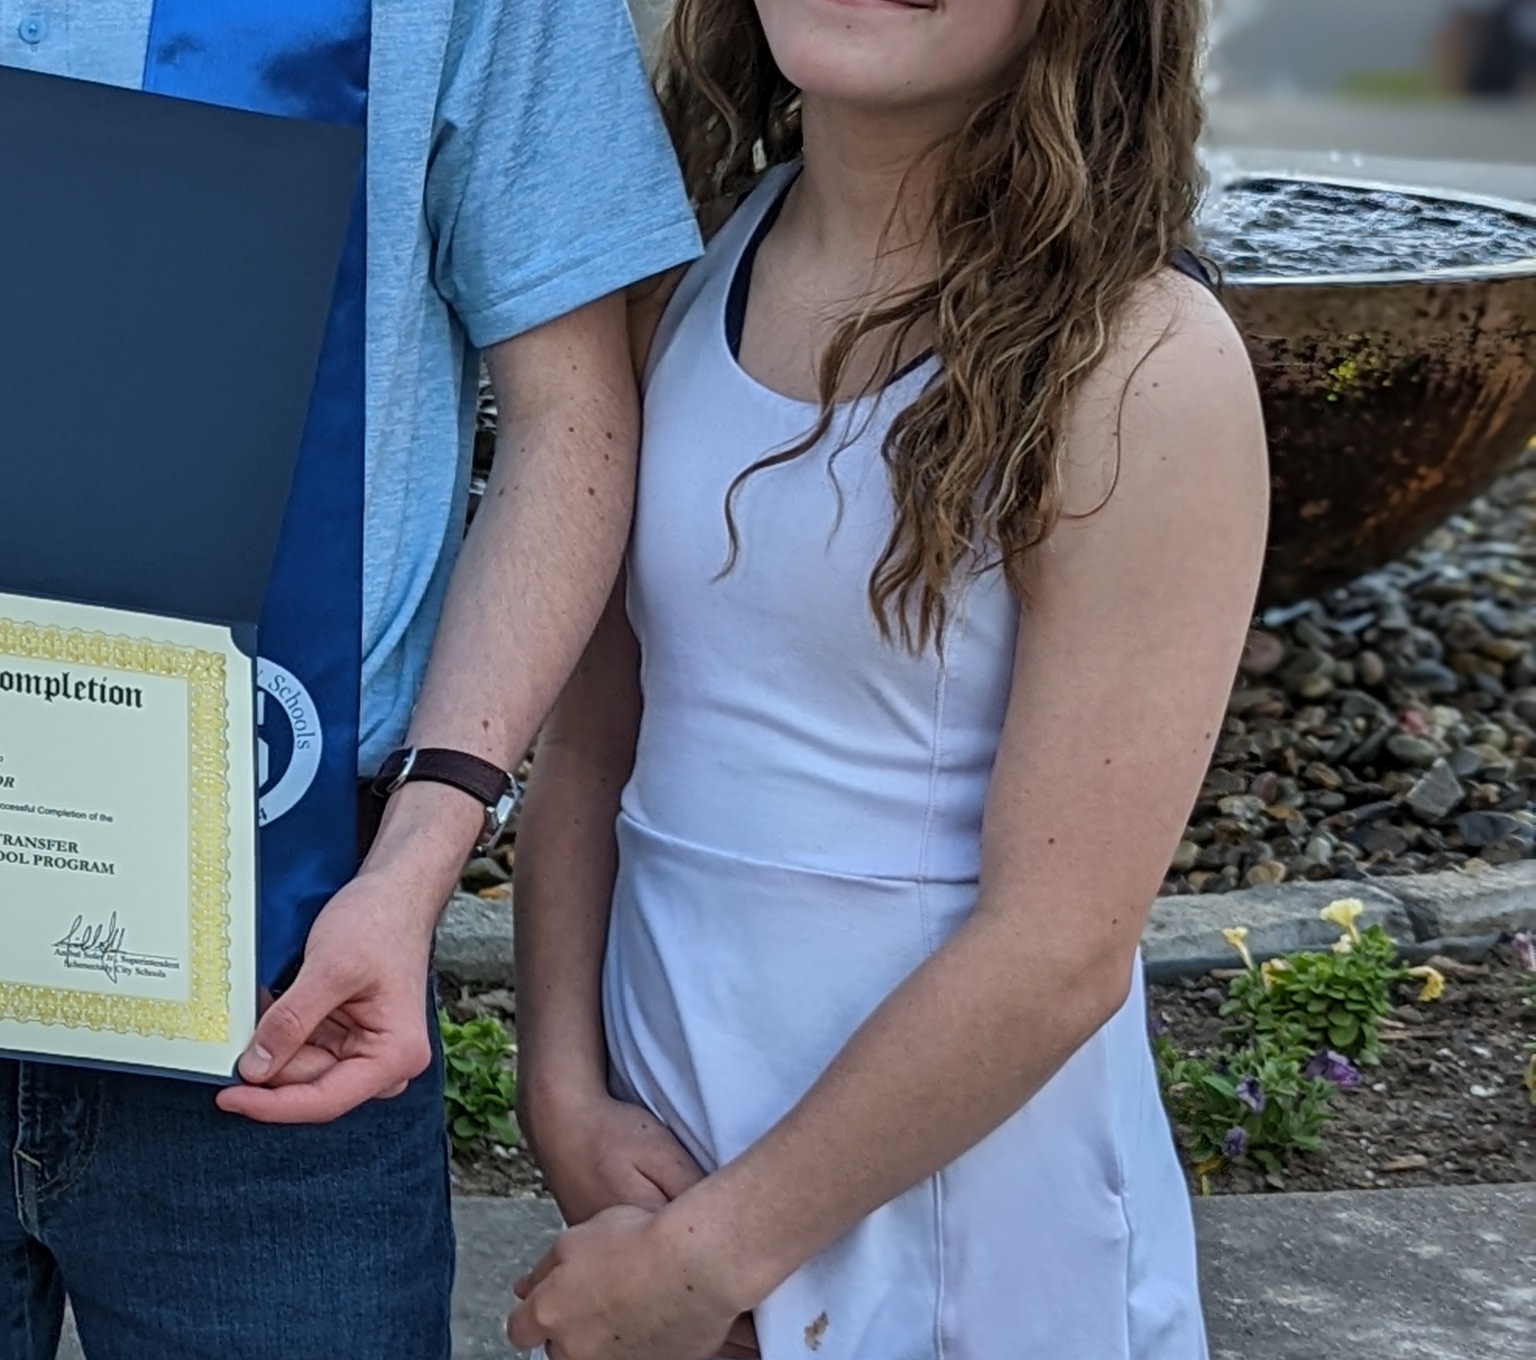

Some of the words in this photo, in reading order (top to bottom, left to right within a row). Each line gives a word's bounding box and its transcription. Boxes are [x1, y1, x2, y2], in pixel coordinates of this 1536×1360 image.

[268, 674, 316, 750] Schools
[37, 805, 87, 819] Completion
[88, 812, 98, 821] of
[99, 813, 113, 823] the
[32, 854, 115, 875] PROGRAM
[135, 967, 166, 978] Schools
